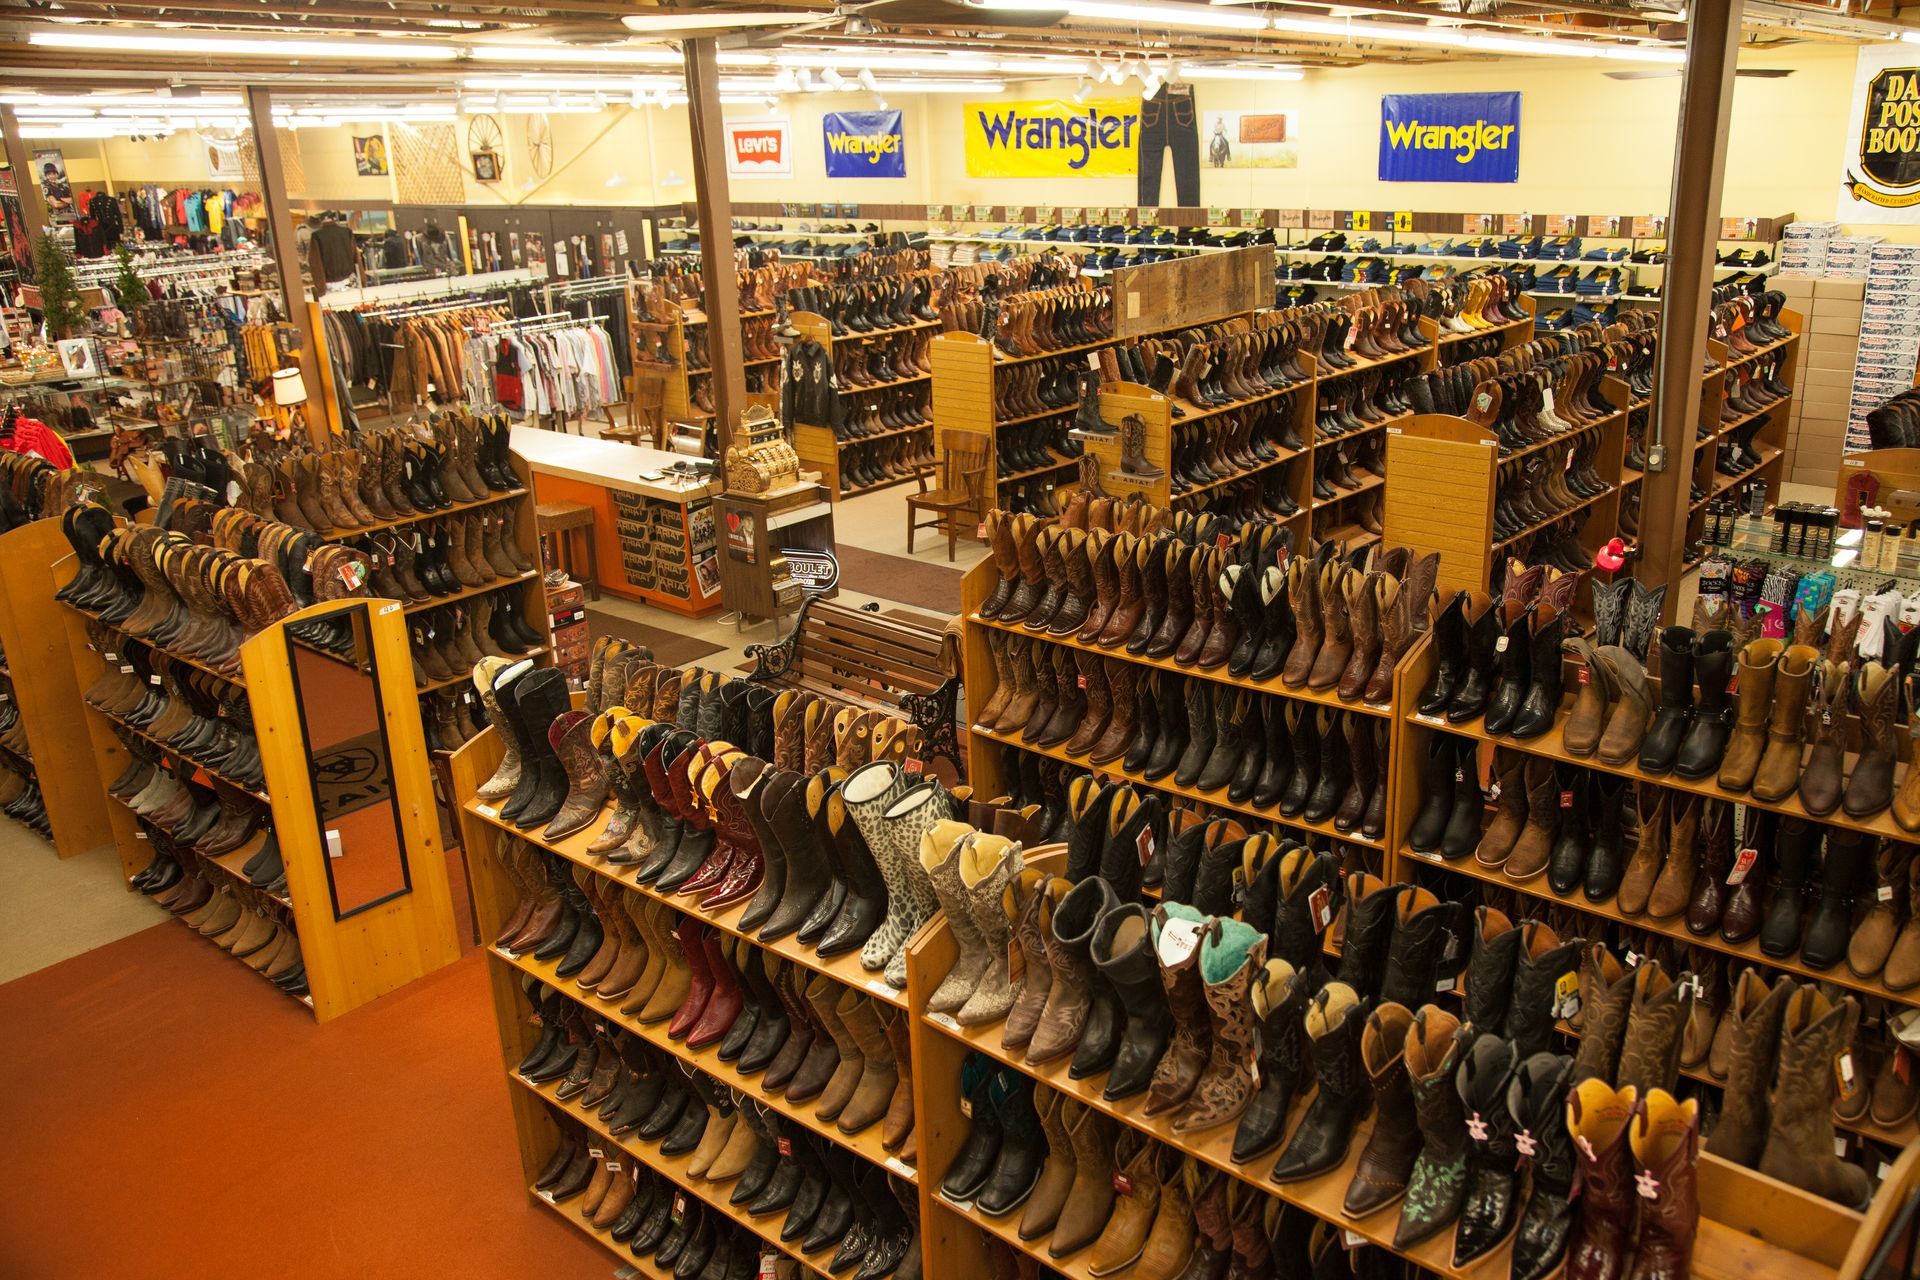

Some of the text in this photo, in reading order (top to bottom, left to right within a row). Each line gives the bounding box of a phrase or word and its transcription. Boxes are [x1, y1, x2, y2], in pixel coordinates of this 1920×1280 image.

[1886, 74, 1920, 101] DA
[1879, 101, 1920, 127] POS
[978, 108, 1137, 169] Wrangler
[1385, 119, 1515, 164] Wrangler
[826, 130, 901, 164] Wrangler
[1083, 435, 1109, 443] ARIAT
[1123, 478, 1150, 486] ARIAT
[662, 511, 683, 521] ARIA
[617, 522, 641, 533] ARIAT
[656, 528, 681, 541] ARIAT
[655, 544, 680, 557] ARIAT
[659, 577, 690, 592] ARIAT
